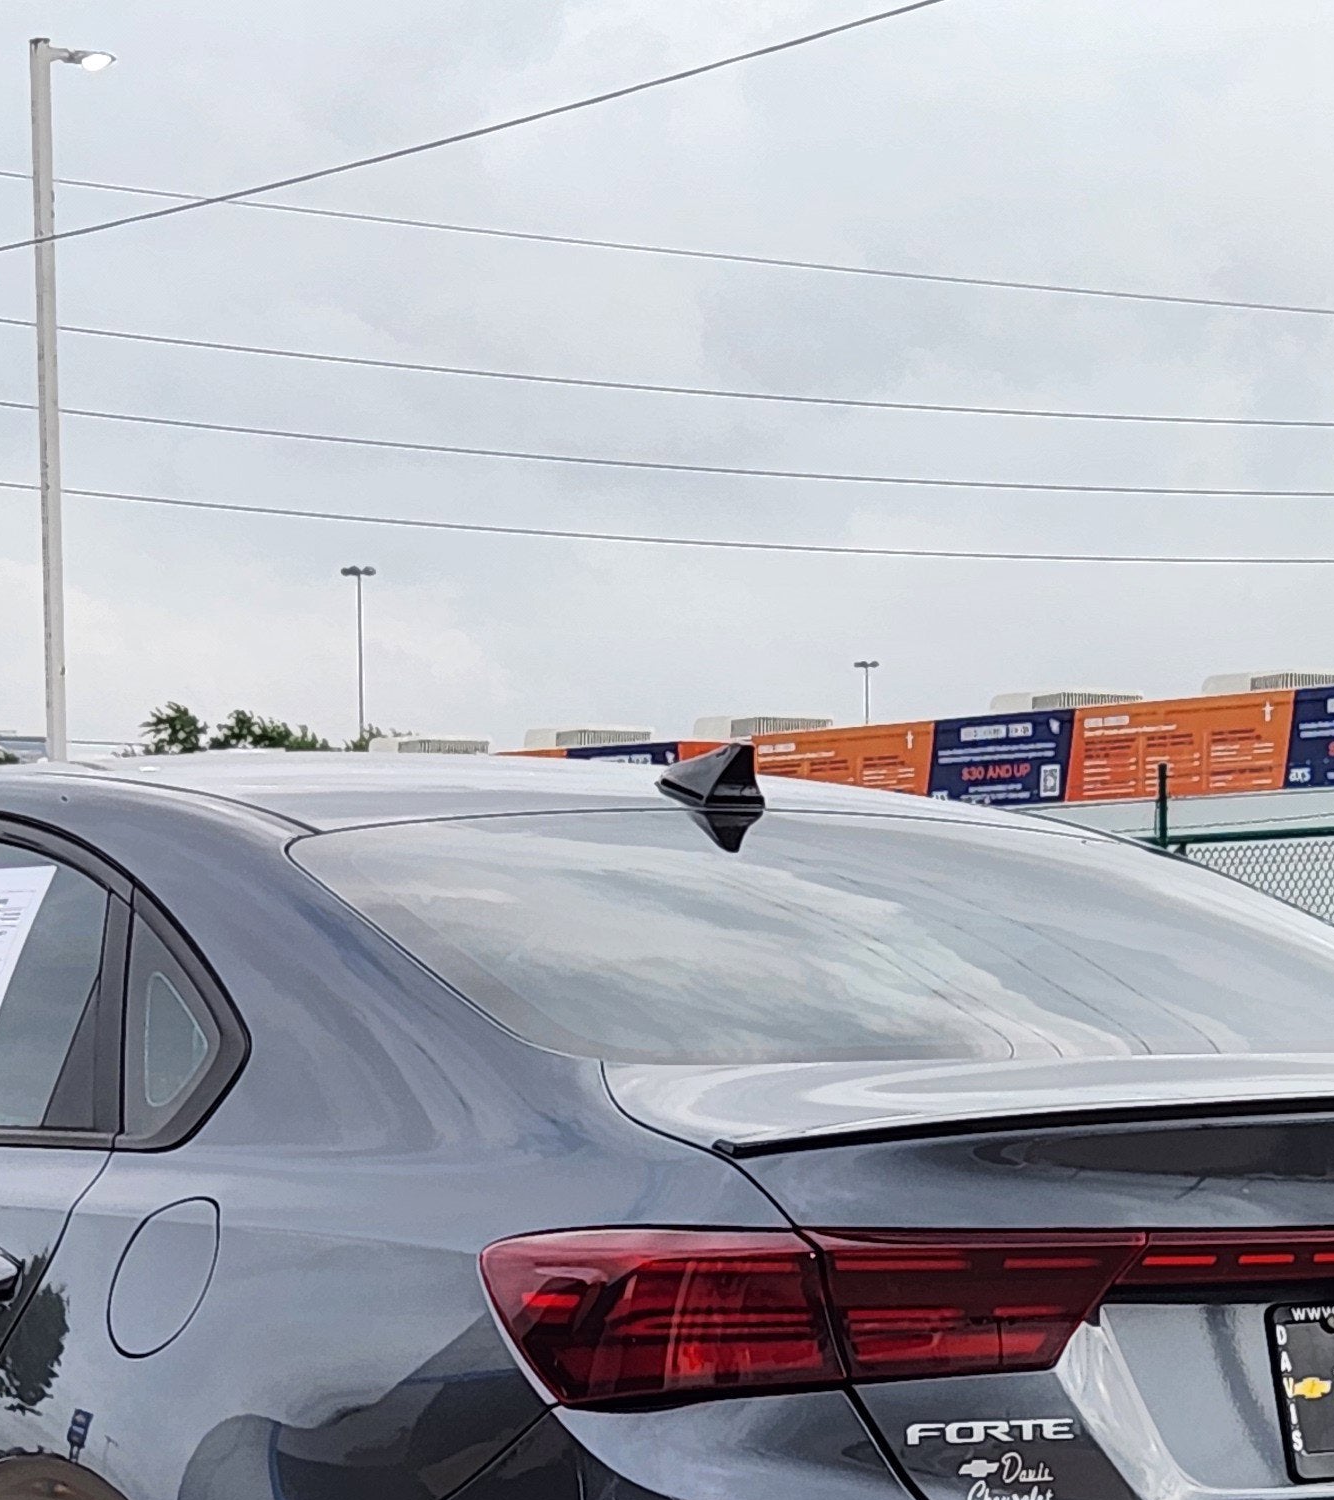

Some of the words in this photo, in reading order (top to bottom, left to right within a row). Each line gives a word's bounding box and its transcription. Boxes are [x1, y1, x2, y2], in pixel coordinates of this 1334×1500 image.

[961, 767, 985, 781] $30
[986, 765, 1013, 780] AND
[1014, 763, 1032, 777] UP
[1275, 1324, 1304, 1452] DAVIS
[905, 1417, 1075, 1446] FORTE
[1000, 1451, 1055, 1484] Davis
